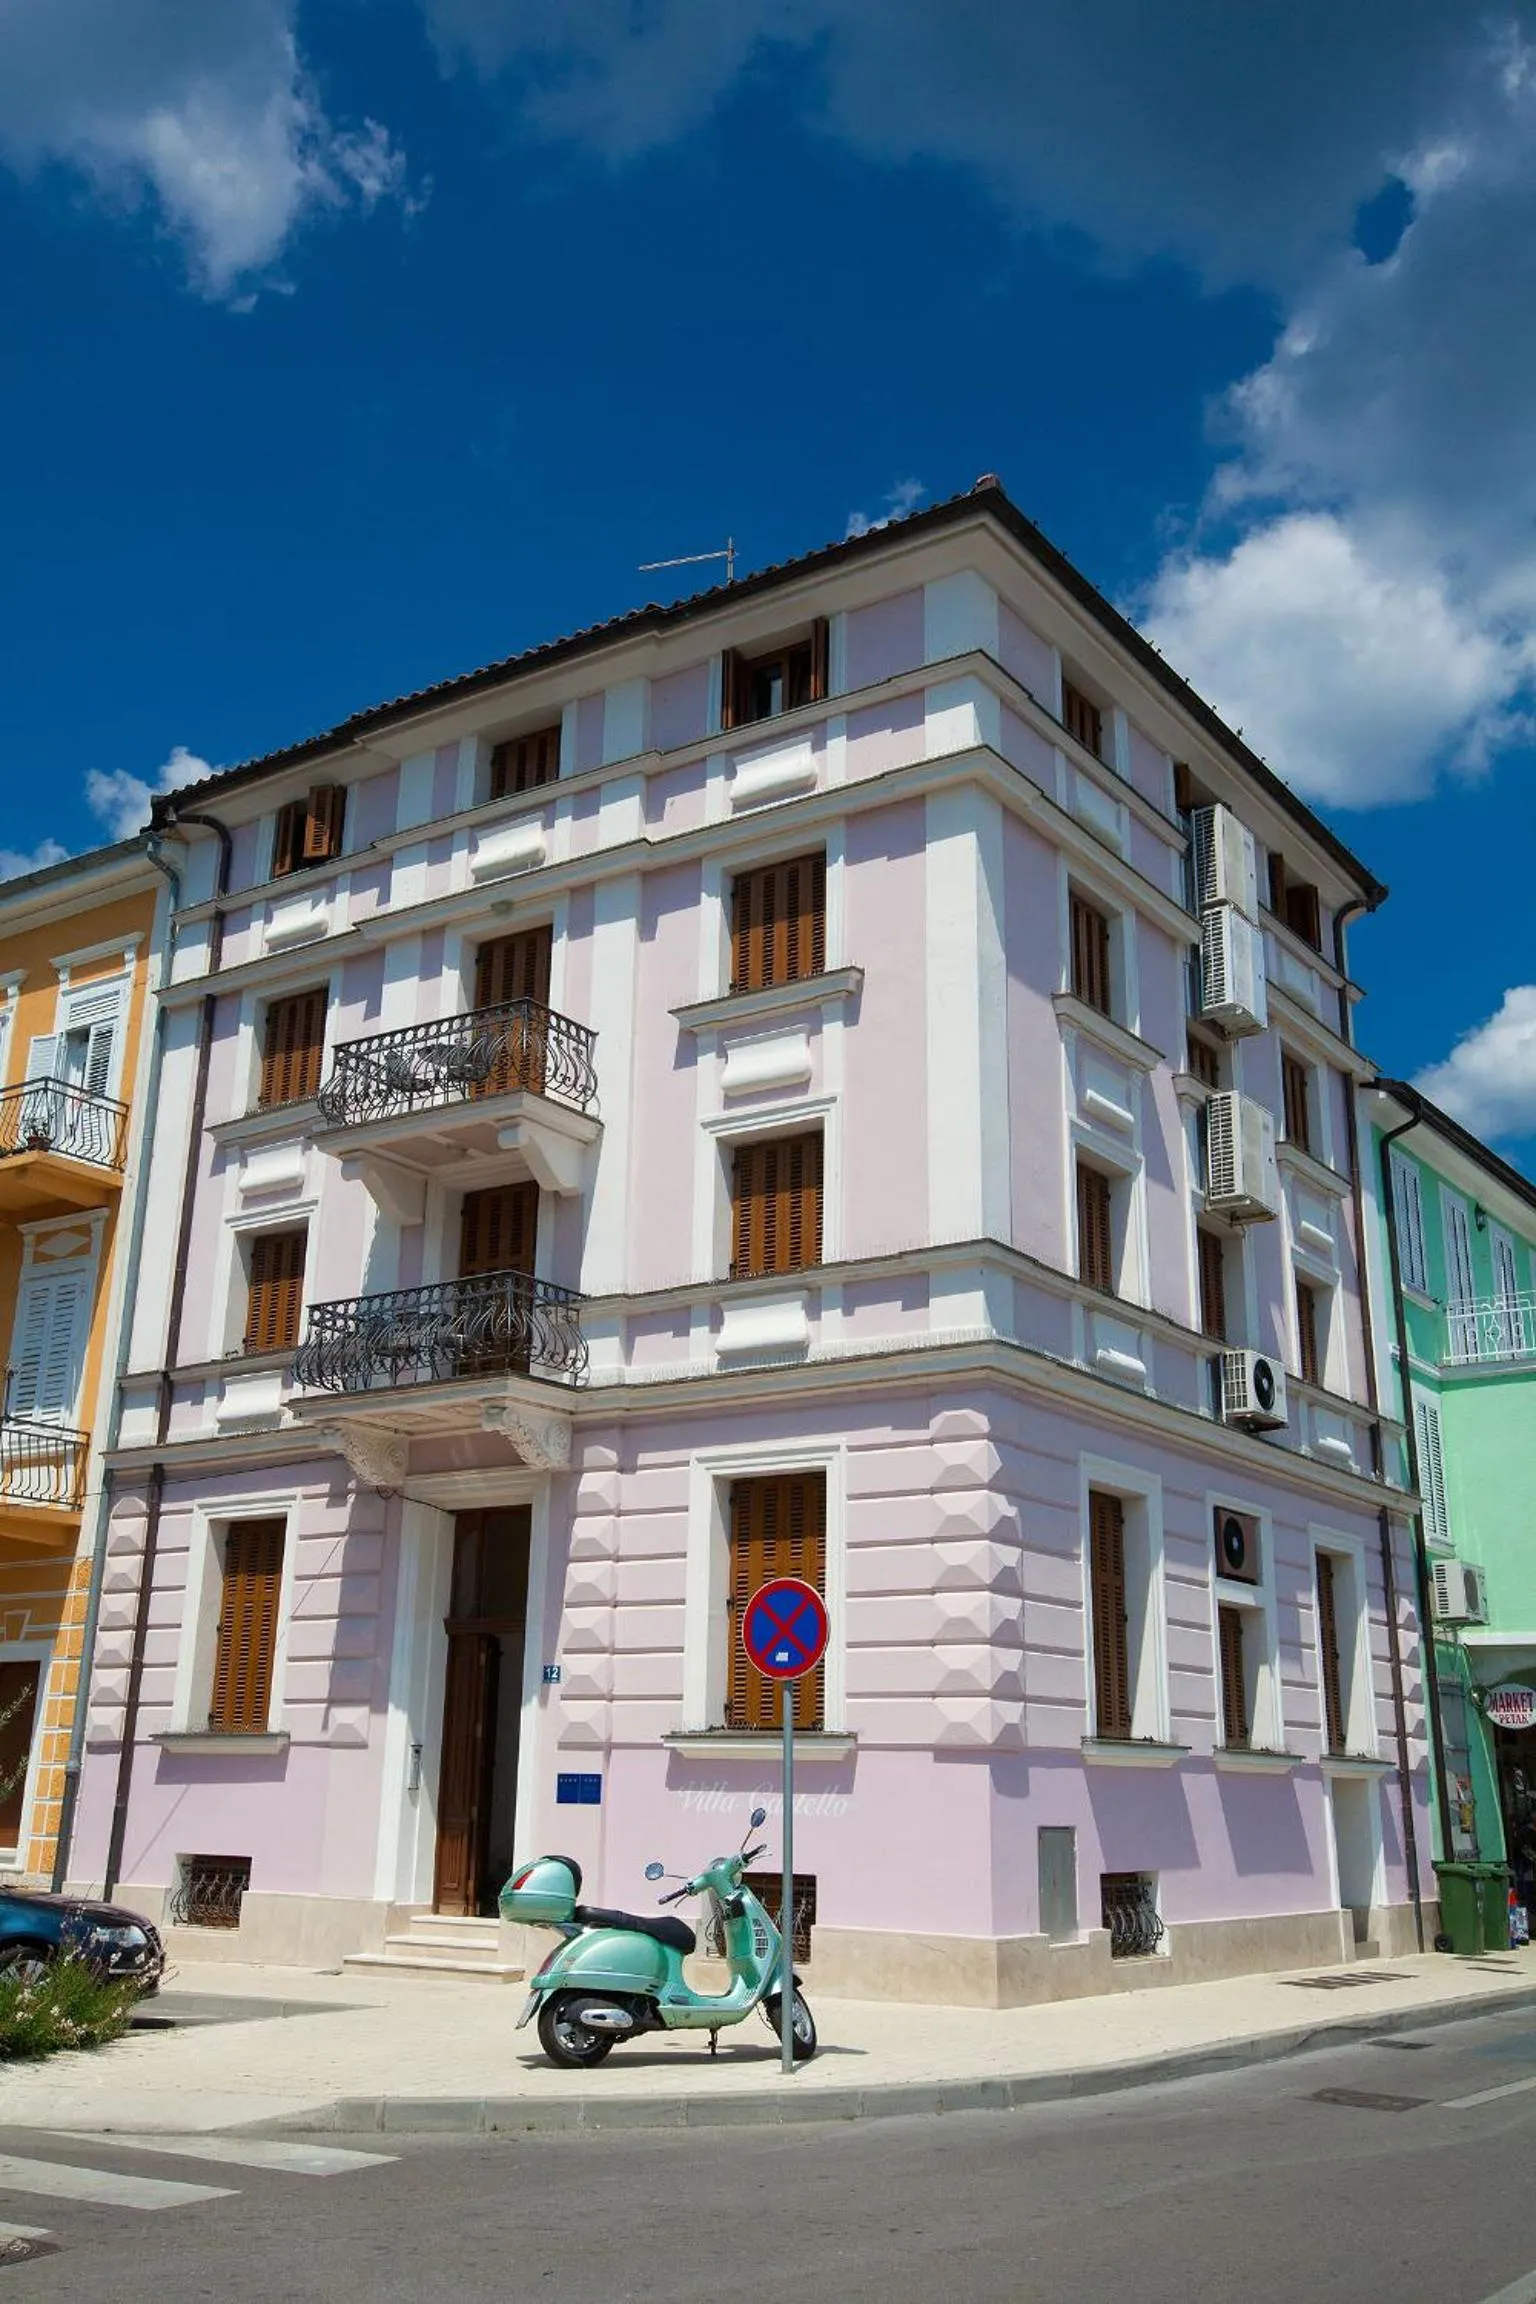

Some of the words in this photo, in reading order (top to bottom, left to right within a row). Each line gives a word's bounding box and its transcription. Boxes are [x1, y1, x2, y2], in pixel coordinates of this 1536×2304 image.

[546, 1667, 559, 1678] 12
[1488, 1691, 1534, 1713] MARKET
[679, 1780, 736, 1813] Villa
[748, 1780, 848, 1816] Catello
